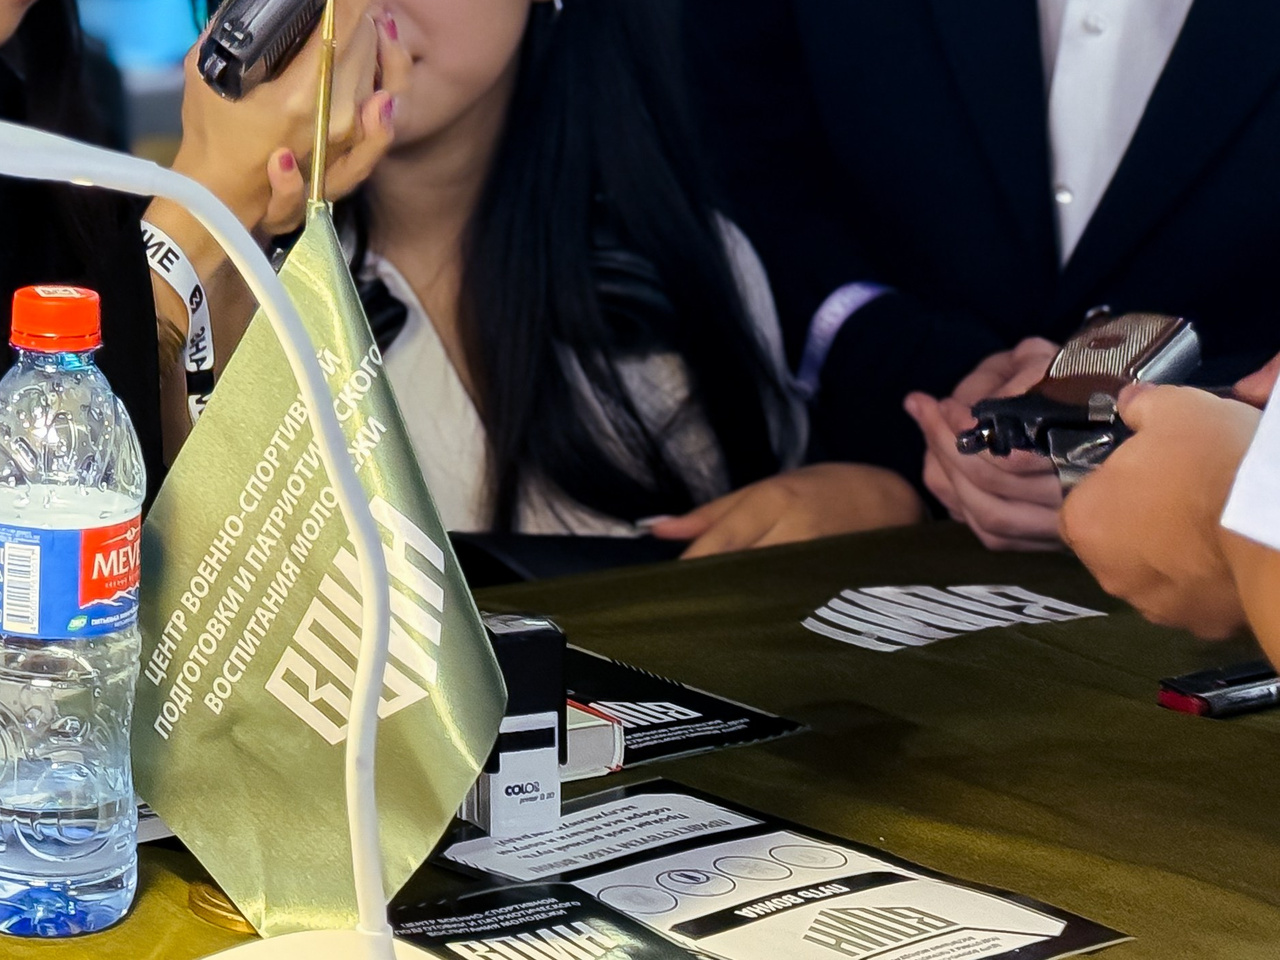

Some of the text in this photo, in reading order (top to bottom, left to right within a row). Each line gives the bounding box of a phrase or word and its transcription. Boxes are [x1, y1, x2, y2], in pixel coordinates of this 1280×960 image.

[144, 344, 342, 686] ЦЕНТР ВОЕННО-СПОРТИВЙ
[153, 344, 383, 740] ПОДГОТОВКИ И ПАТРИОТИСКОГО
[203, 416, 388, 715] ВОСПИТАНИЯ МОЛОЖИ
[734, 883, 850, 919] ПУТЬ ВОИНА
